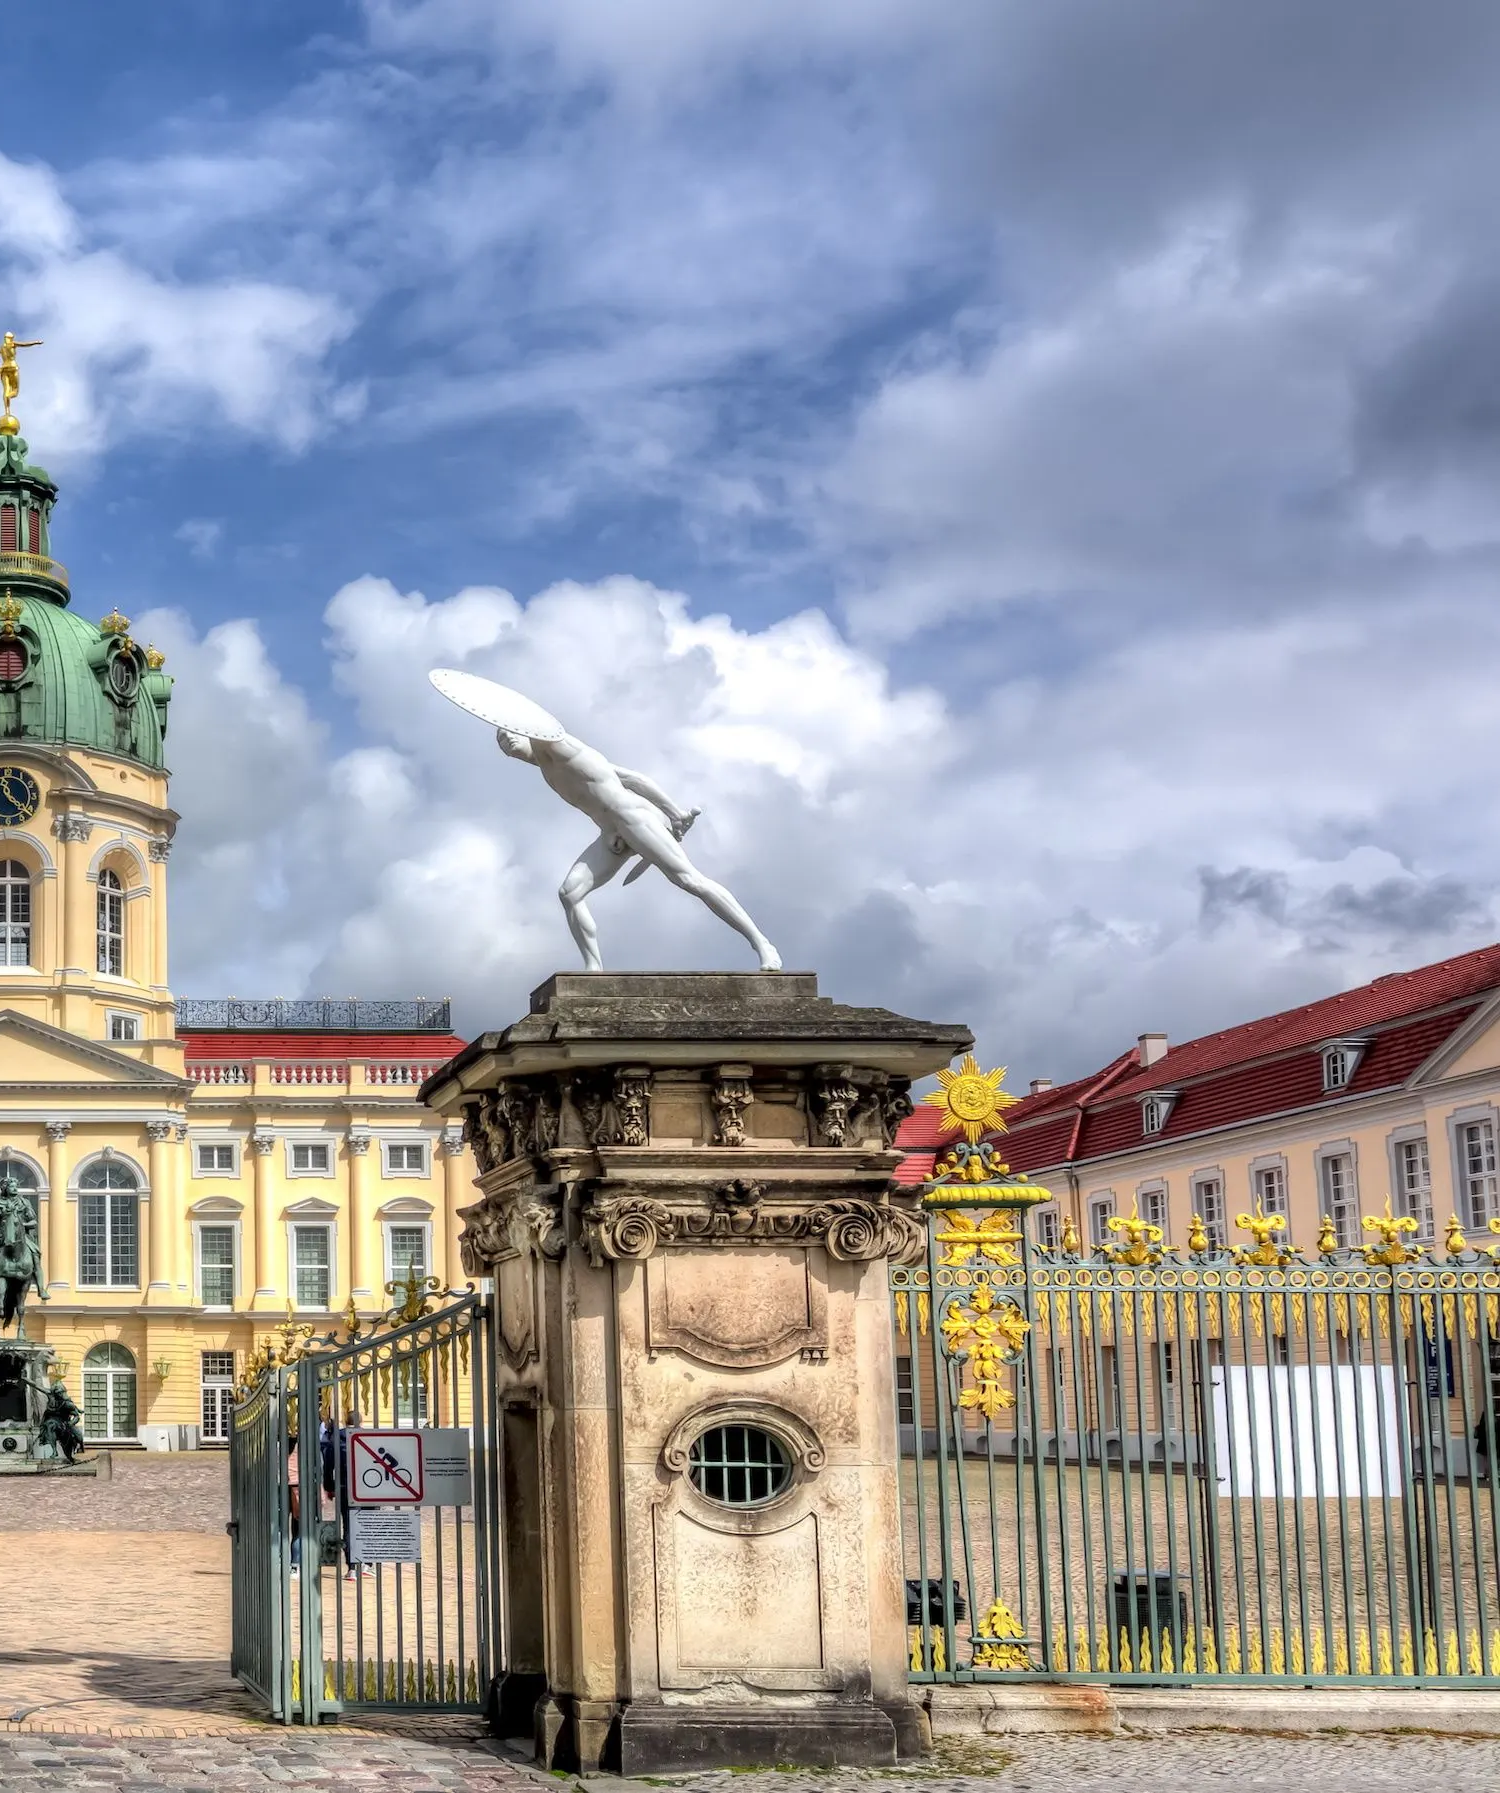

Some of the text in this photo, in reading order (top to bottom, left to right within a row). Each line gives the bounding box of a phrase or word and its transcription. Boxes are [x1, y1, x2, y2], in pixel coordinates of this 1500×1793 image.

[4, 769, 12, 777] 12
[27, 780, 34, 788] 2
[31, 792, 37, 800] 3
[5, 817, 11, 825] 6
